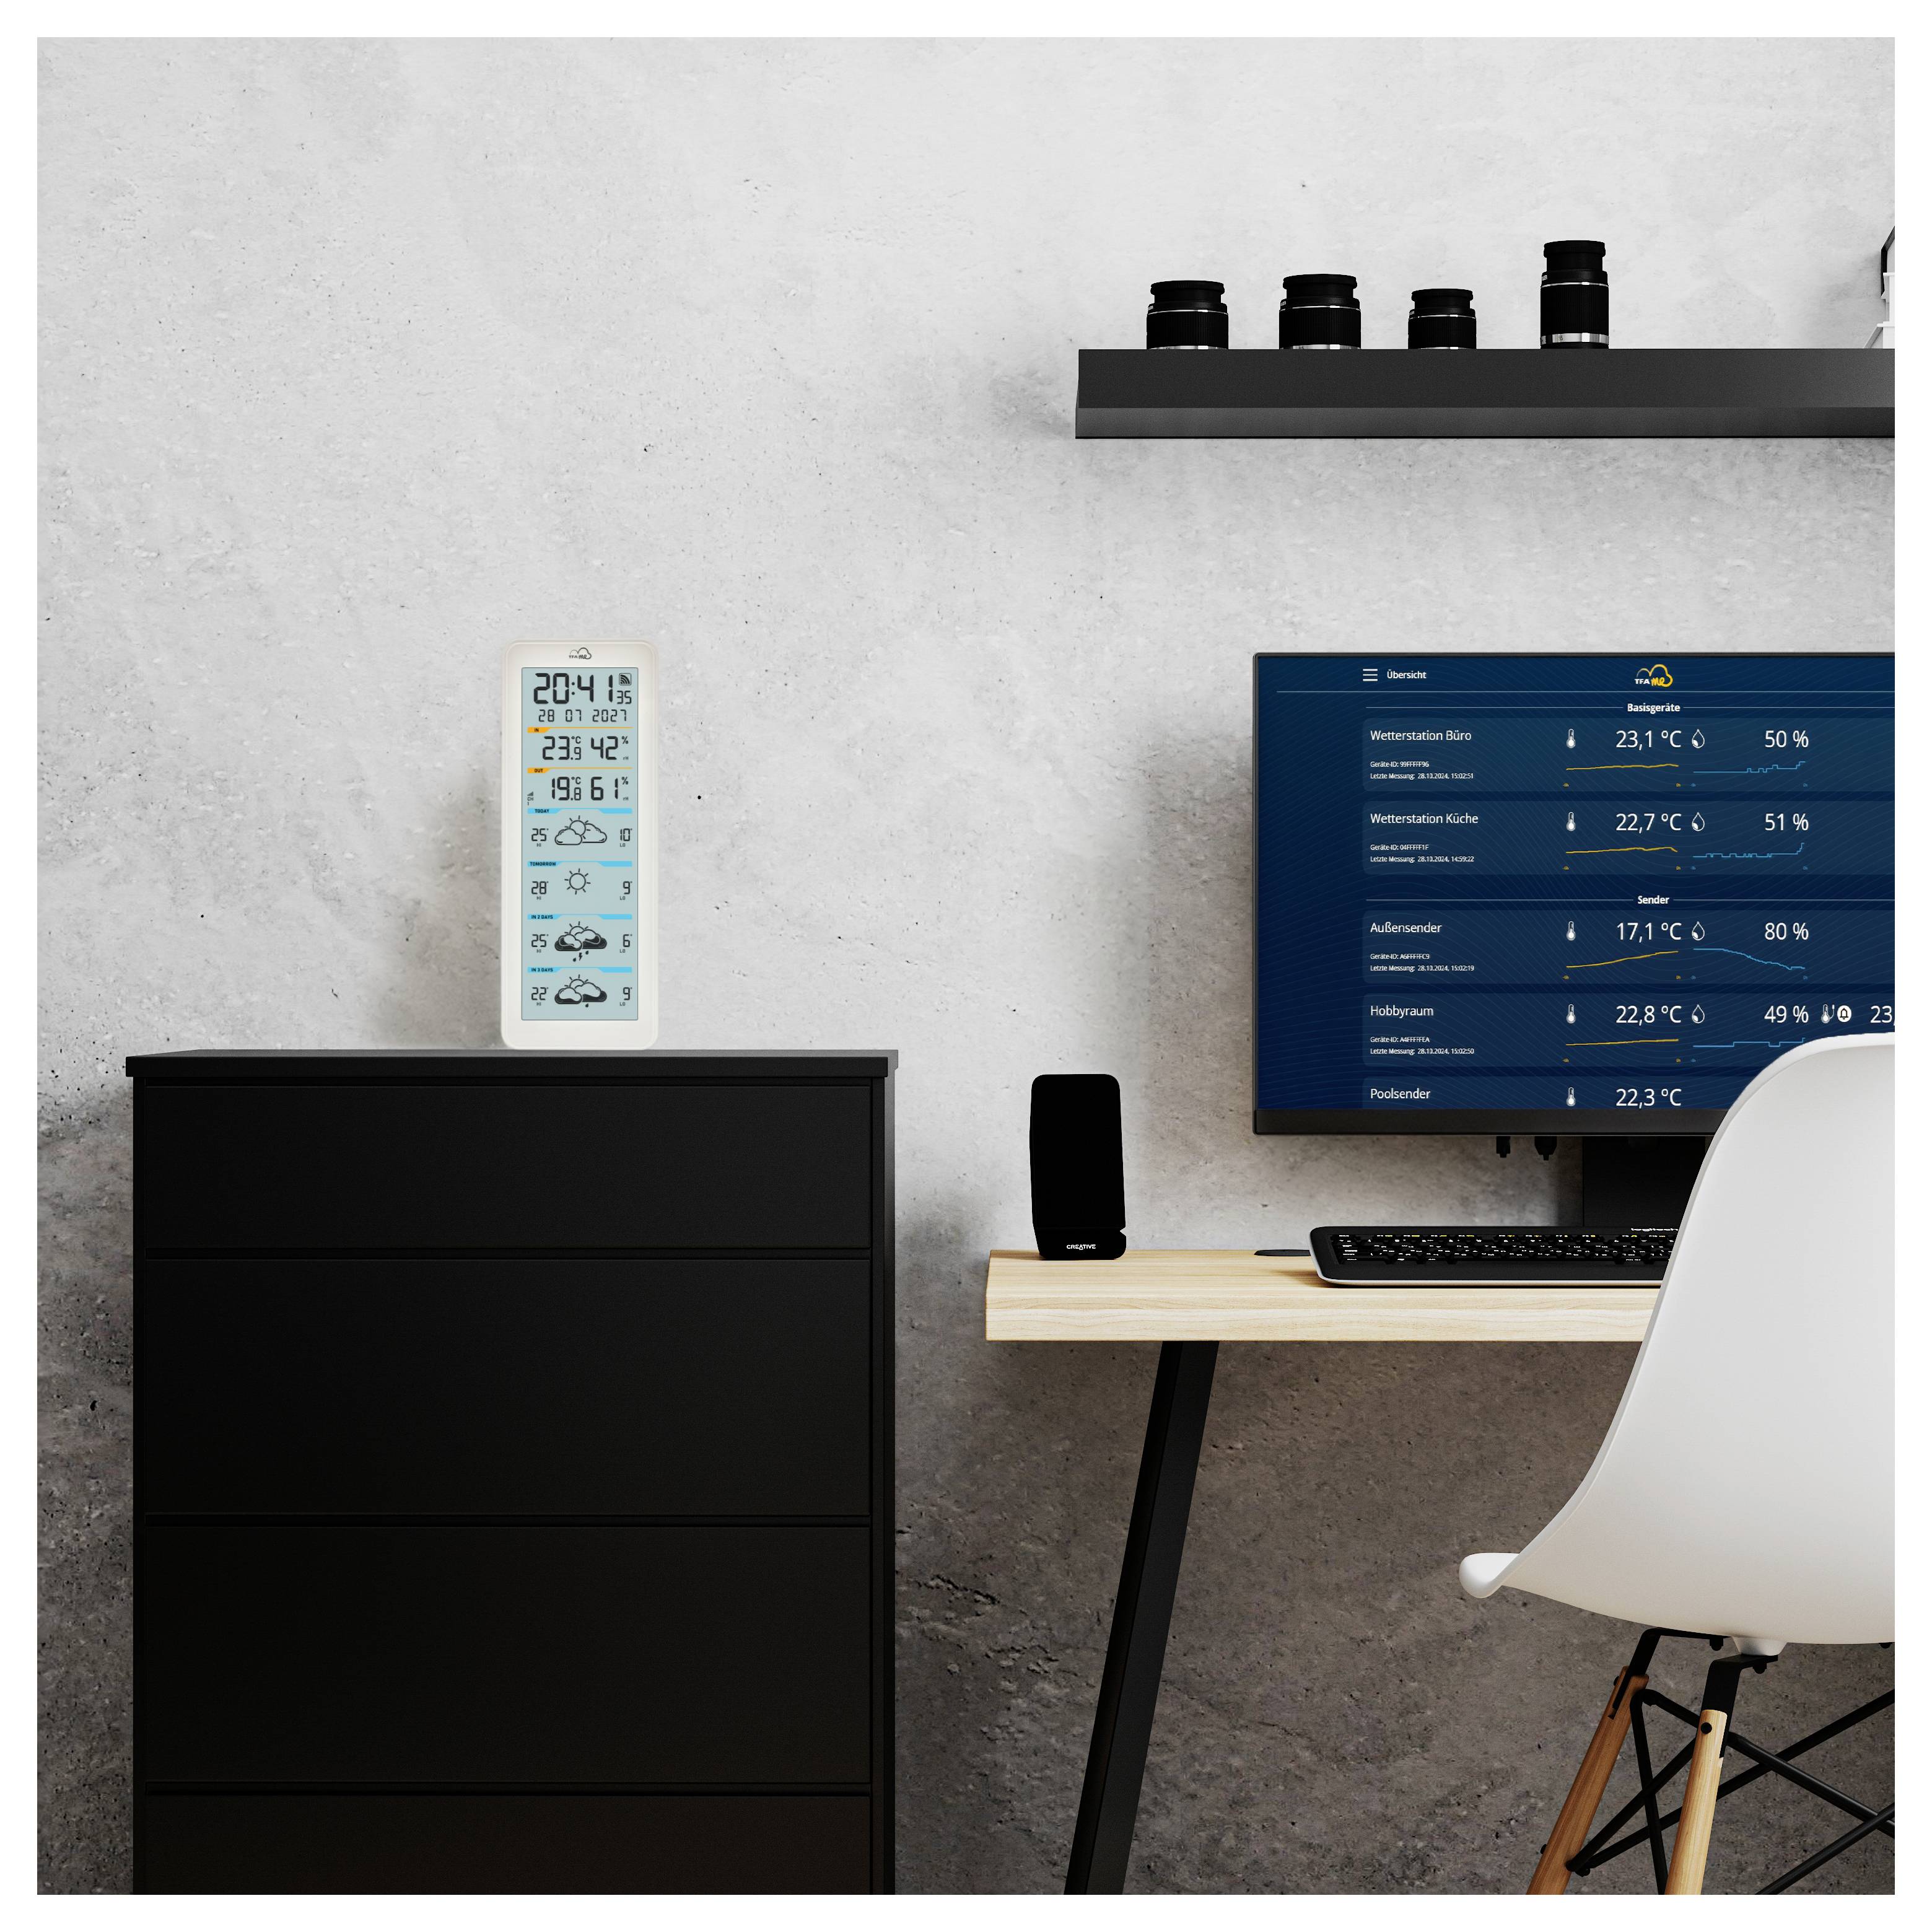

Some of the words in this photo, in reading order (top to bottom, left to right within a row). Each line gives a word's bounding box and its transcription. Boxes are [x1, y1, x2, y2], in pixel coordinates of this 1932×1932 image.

[1388, 670, 1426, 678] Übersicht
[534, 673, 613, 704] 20:41
[617, 691, 631, 704] 35
[539, 709, 554, 722] 28
[566, 709, 581, 722] 07
[593, 709, 626, 722] 2027
[1628, 703, 1680, 714] Basisgeräte
[1371, 730, 1442, 740] Wetterstation
[1446, 730, 1471, 740] Büro
[1617, 731, 1651, 750] 23,1
[1765, 730, 1786, 747] 50
[1793, 730, 1808, 747] %
[591, 737, 618, 760] 42
[622, 736, 628, 744] %
[1388, 772, 1415, 780] Messung:
[591, 777, 618, 800] 61
[1371, 813, 1443, 823] Wetterstation
[1446, 813, 1478, 823] Küche
[1616, 813, 1654, 833] 22,7
[1765, 814, 1783, 830] 51
[1793, 813, 1808, 830] %
[1638, 895, 1669, 904] Sender
[1371, 922, 1442, 932] Außensender
[1617, 923, 1651, 943] 17,1
[1765, 923, 1786, 940] 80
[1793, 923, 1808, 940] %
[1371, 1005, 1433, 1018] Hobbyraum
[1617, 1006, 1654, 1026] 22,8
[1765, 1006, 1786, 1023] 49
[1793, 1006, 1809, 1023] %
[1371, 1088, 1430, 1098] Poolsender
[1617, 1089, 1654, 1108] 22,3
